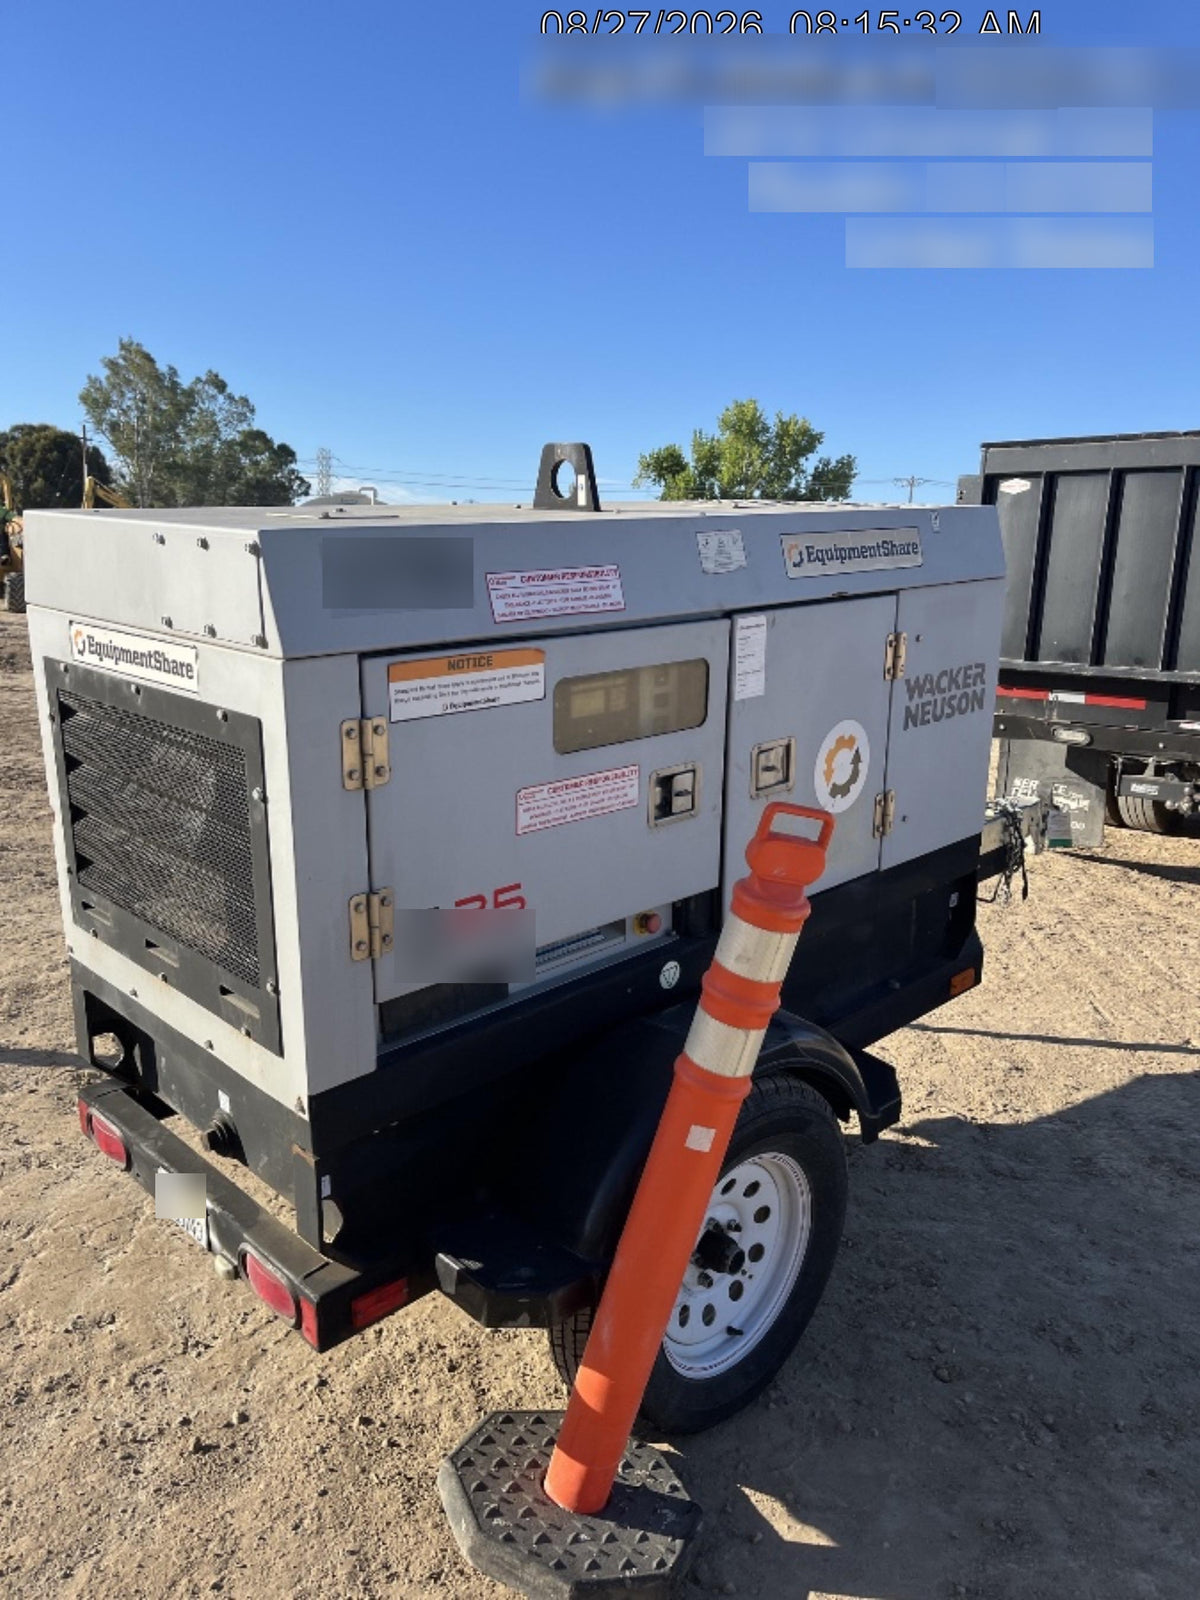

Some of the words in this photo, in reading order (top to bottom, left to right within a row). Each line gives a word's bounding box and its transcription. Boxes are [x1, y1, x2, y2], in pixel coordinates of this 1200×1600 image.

[805, 540, 919, 566] EquipmentShare
[87, 634, 194, 679] EquipmentShare
[448, 655, 493, 671] NOTICE
[904, 662, 986, 703] WACKER
[903, 687, 986, 731] NEUSON
